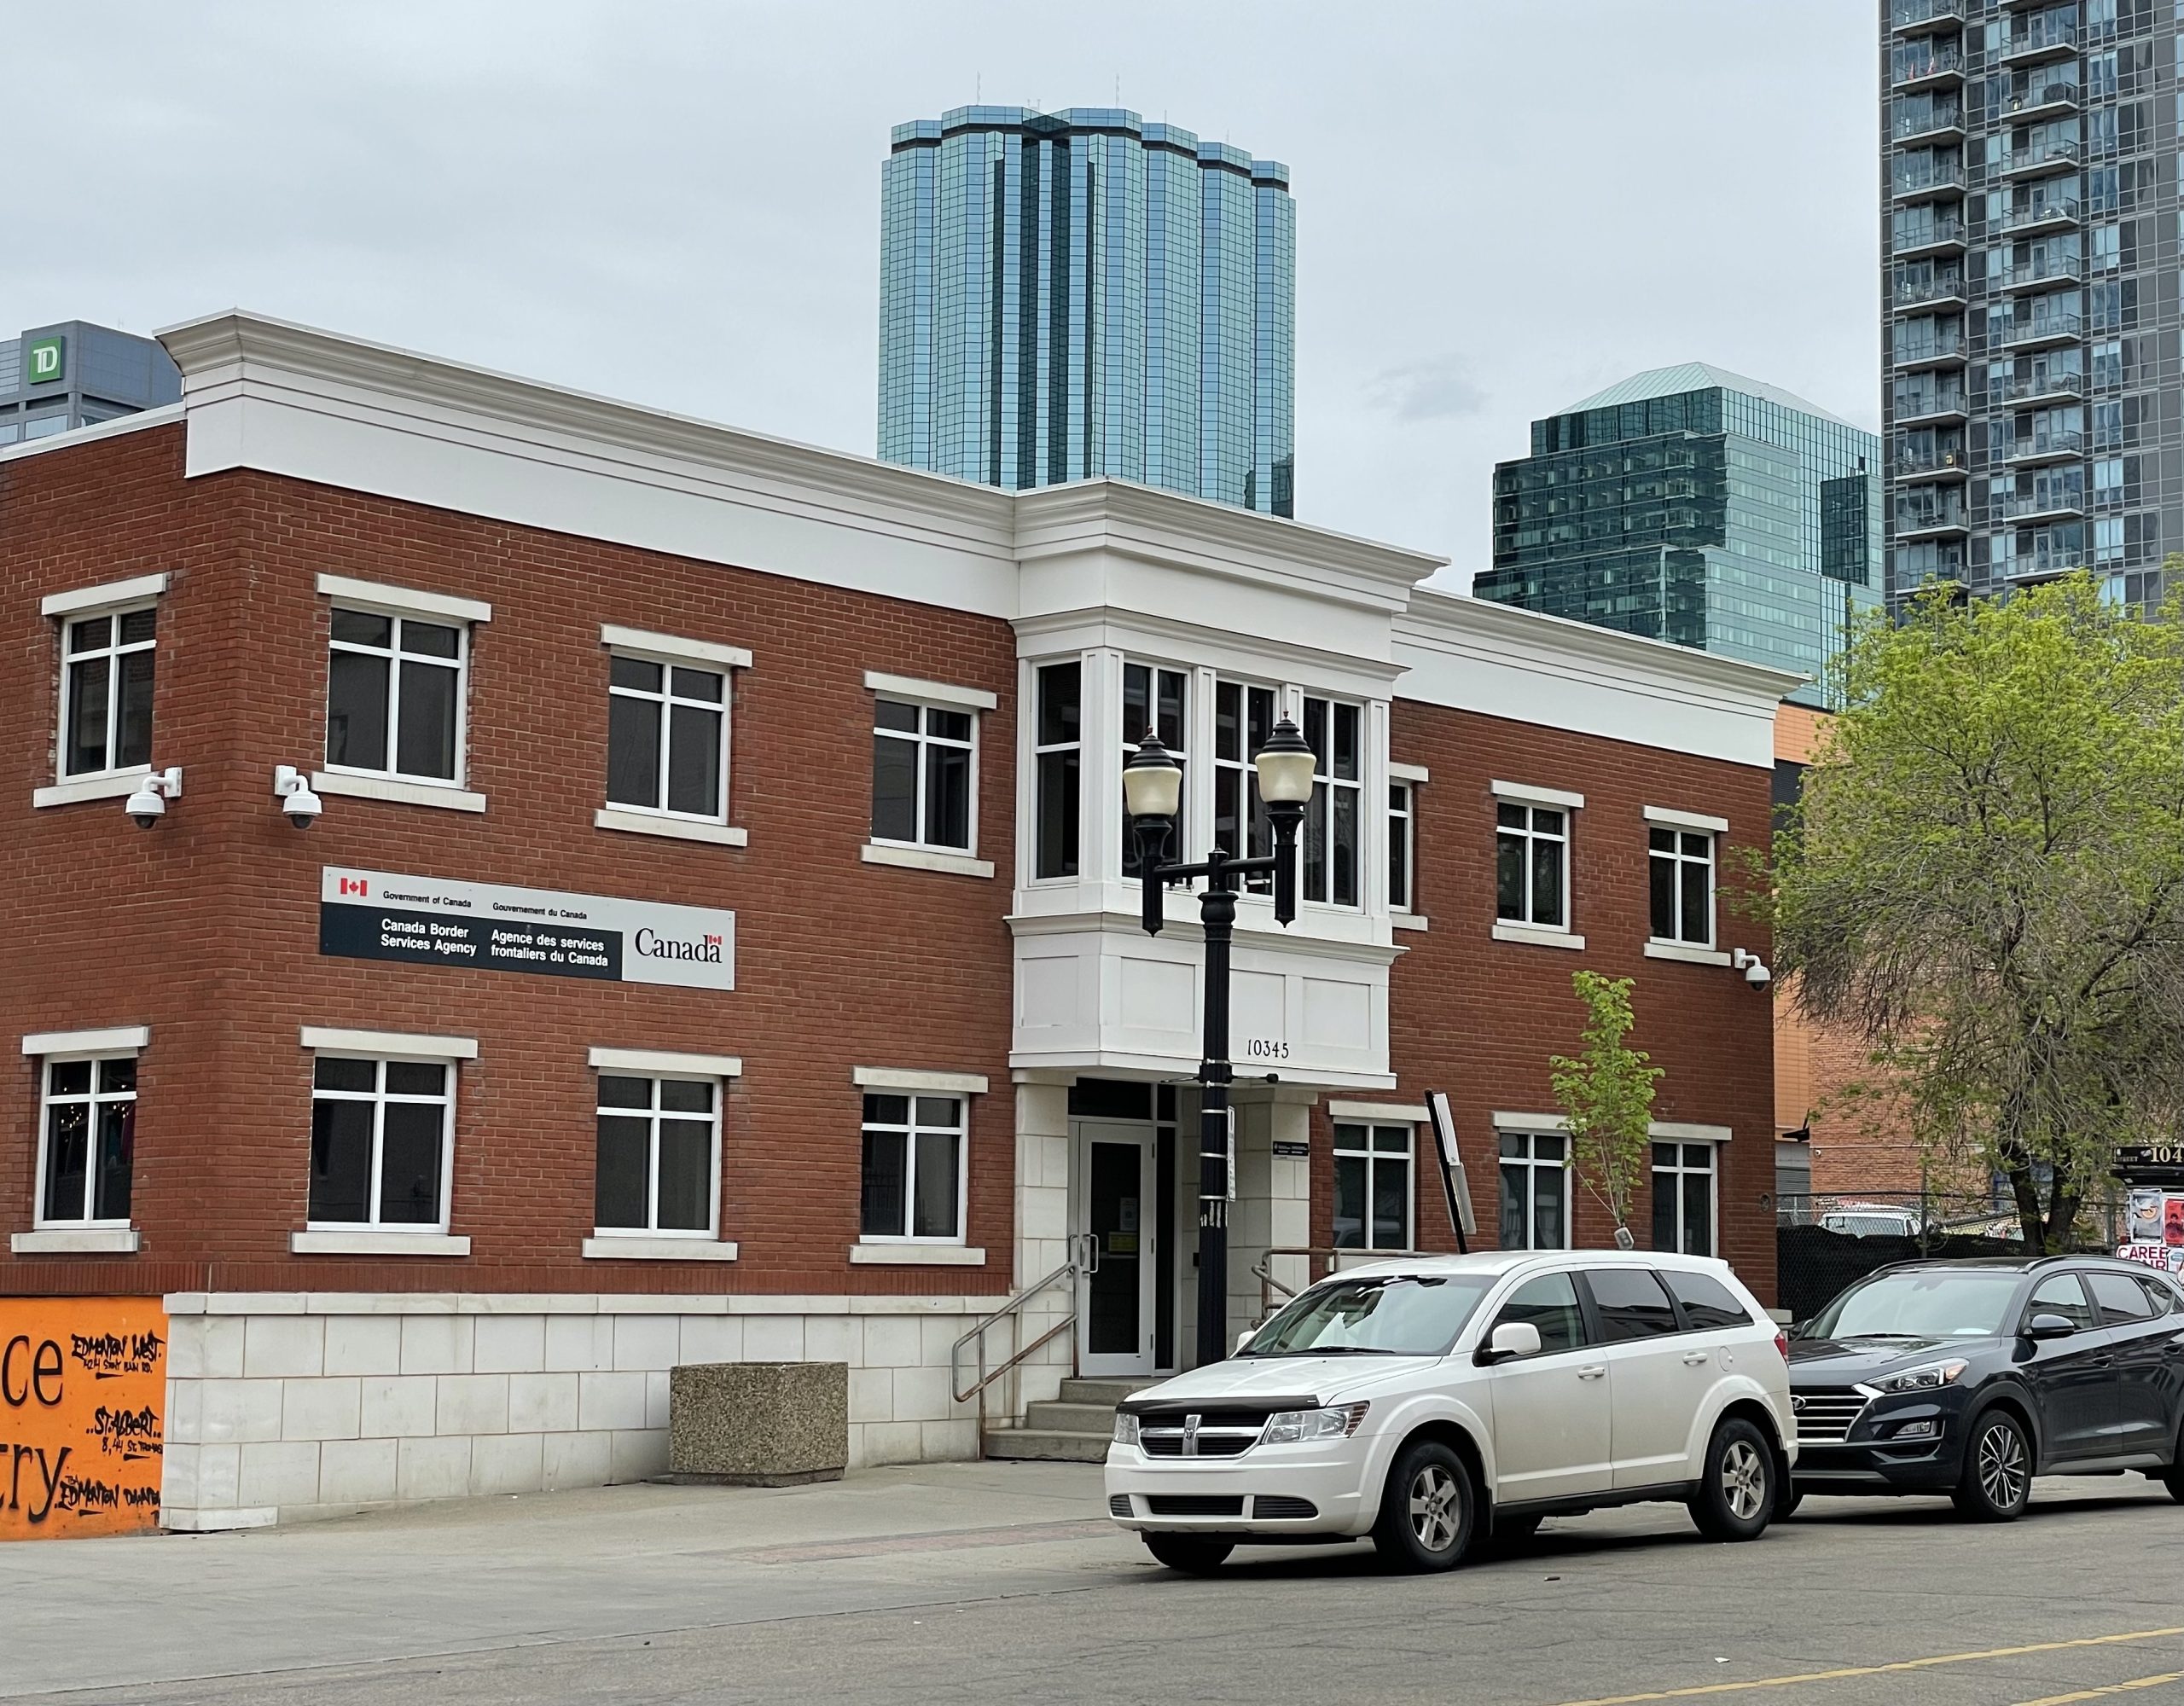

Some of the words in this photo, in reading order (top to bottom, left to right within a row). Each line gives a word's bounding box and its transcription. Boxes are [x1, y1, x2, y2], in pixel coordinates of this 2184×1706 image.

[32, 345, 58, 374] TD
[382, 891, 430, 904] Government
[432, 896, 441, 904] of
[443, 897, 472, 908] Canada
[492, 902, 546, 916] Gouvernement
[548, 908, 558, 917] du
[560, 909, 588, 920] Canada
[381, 918, 426, 935] Canada
[430, 923, 469, 938] Border
[380, 935, 431, 950] Services
[434, 940, 477, 957] Agency
[491, 928, 532, 946] Agence
[536, 934, 557, 947] des
[560, 937, 605, 952] services
[635, 927, 723, 964] Canada
[491, 944, 547, 961] frontaliers
[549, 951, 565, 963] du
[567, 952, 609, 967] Canada
[1247, 1038, 1289, 1059] 10345
[2118, 1245, 2169, 1259] CAREE
